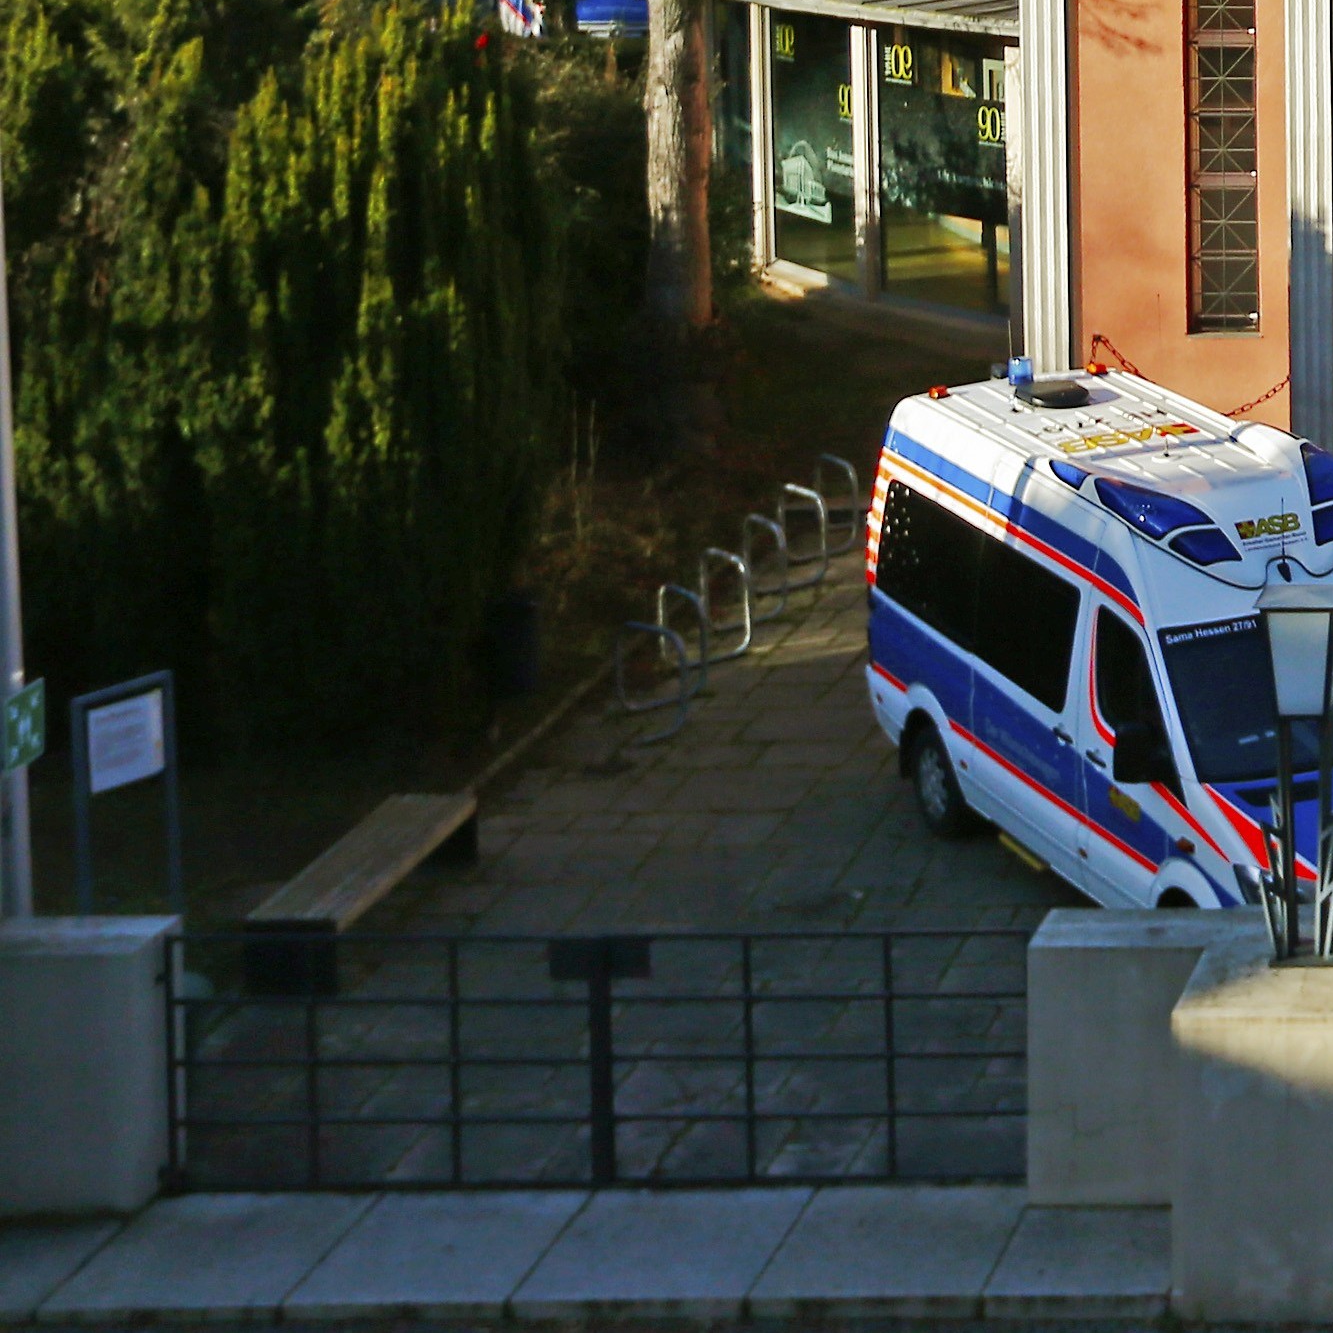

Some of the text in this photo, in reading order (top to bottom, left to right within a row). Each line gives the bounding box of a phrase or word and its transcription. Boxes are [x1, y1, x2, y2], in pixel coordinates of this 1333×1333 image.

[977, 105, 1001, 142] 90
[1256, 512, 1301, 537] ASB
[1194, 624, 1231, 638] Hessen
